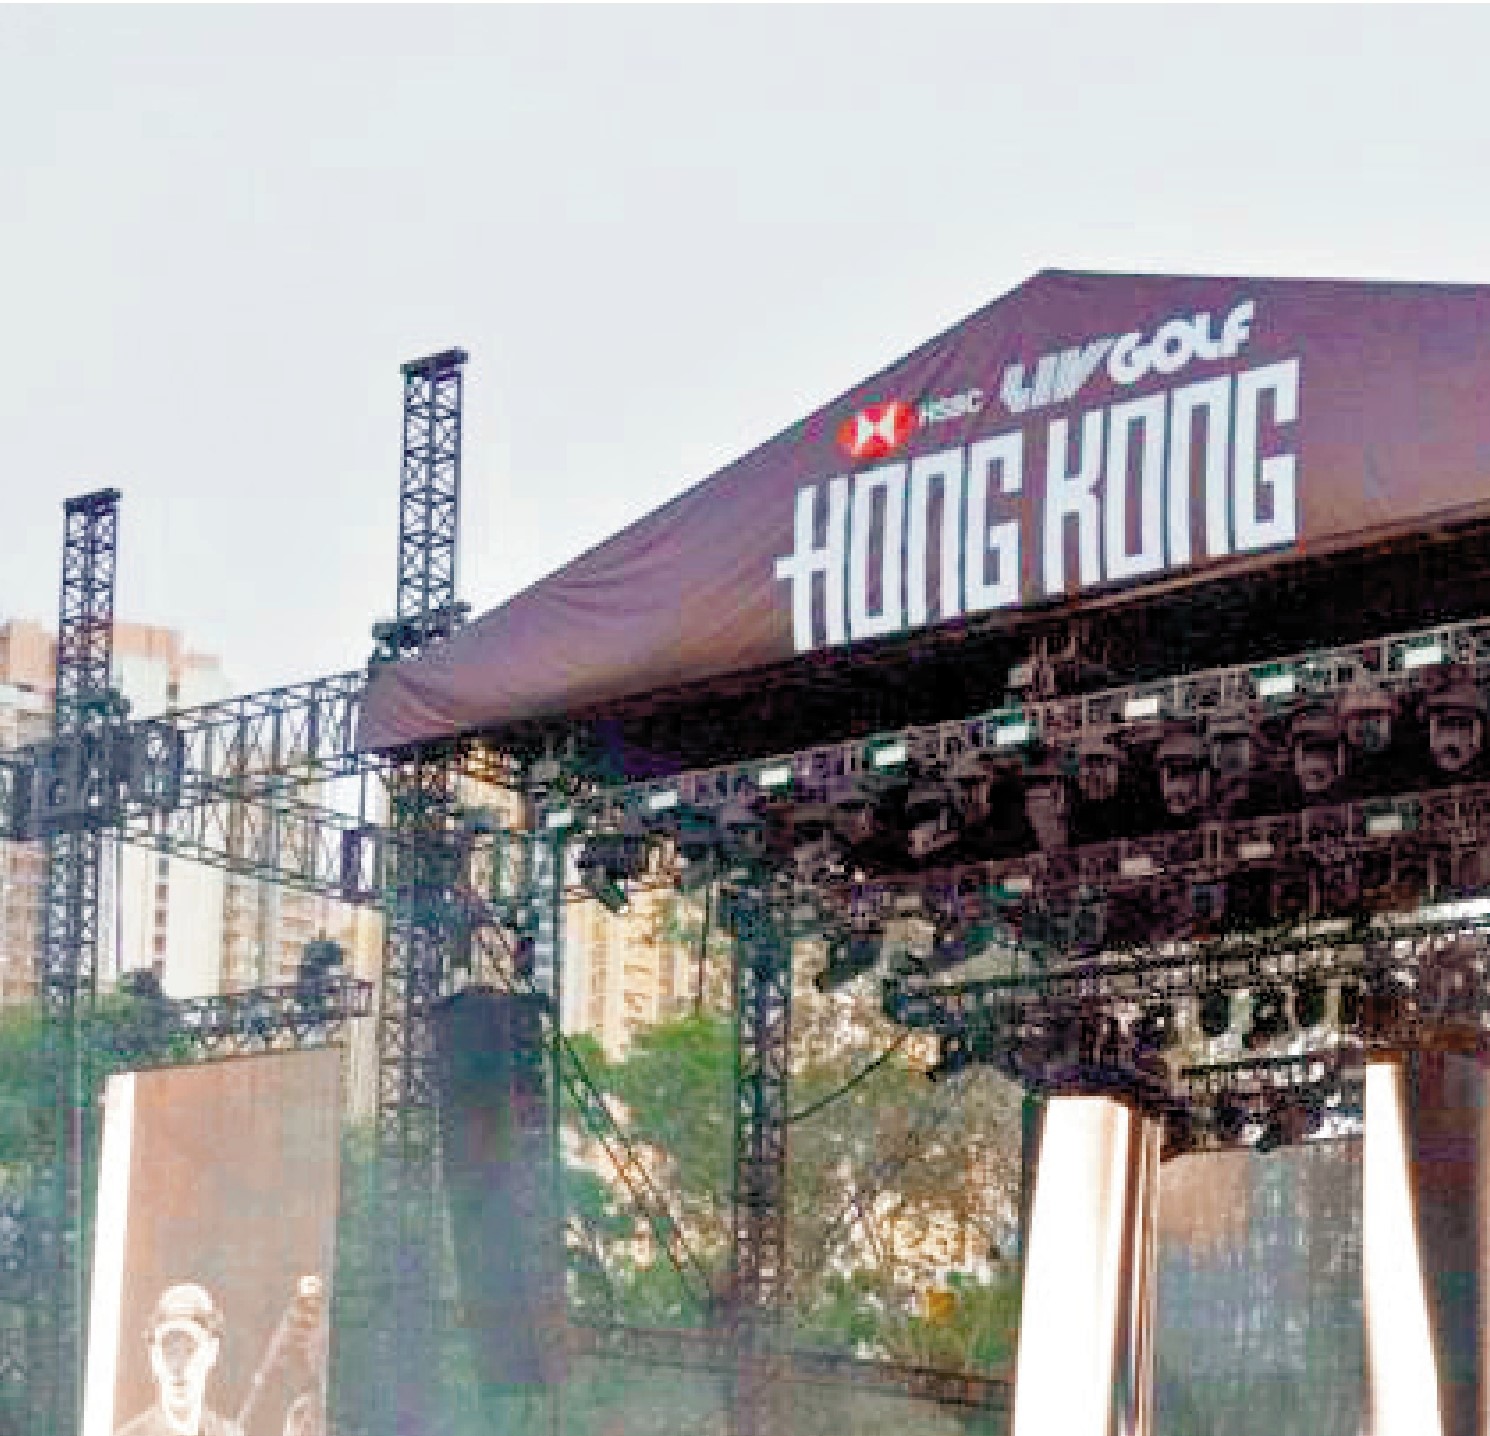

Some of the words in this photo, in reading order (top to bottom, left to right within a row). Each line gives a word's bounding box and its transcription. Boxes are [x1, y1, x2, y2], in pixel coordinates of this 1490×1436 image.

[1107, 301, 1254, 384] GOLF
[775, 431, 1023, 654] HONG
[1045, 360, 1299, 594] KONG
